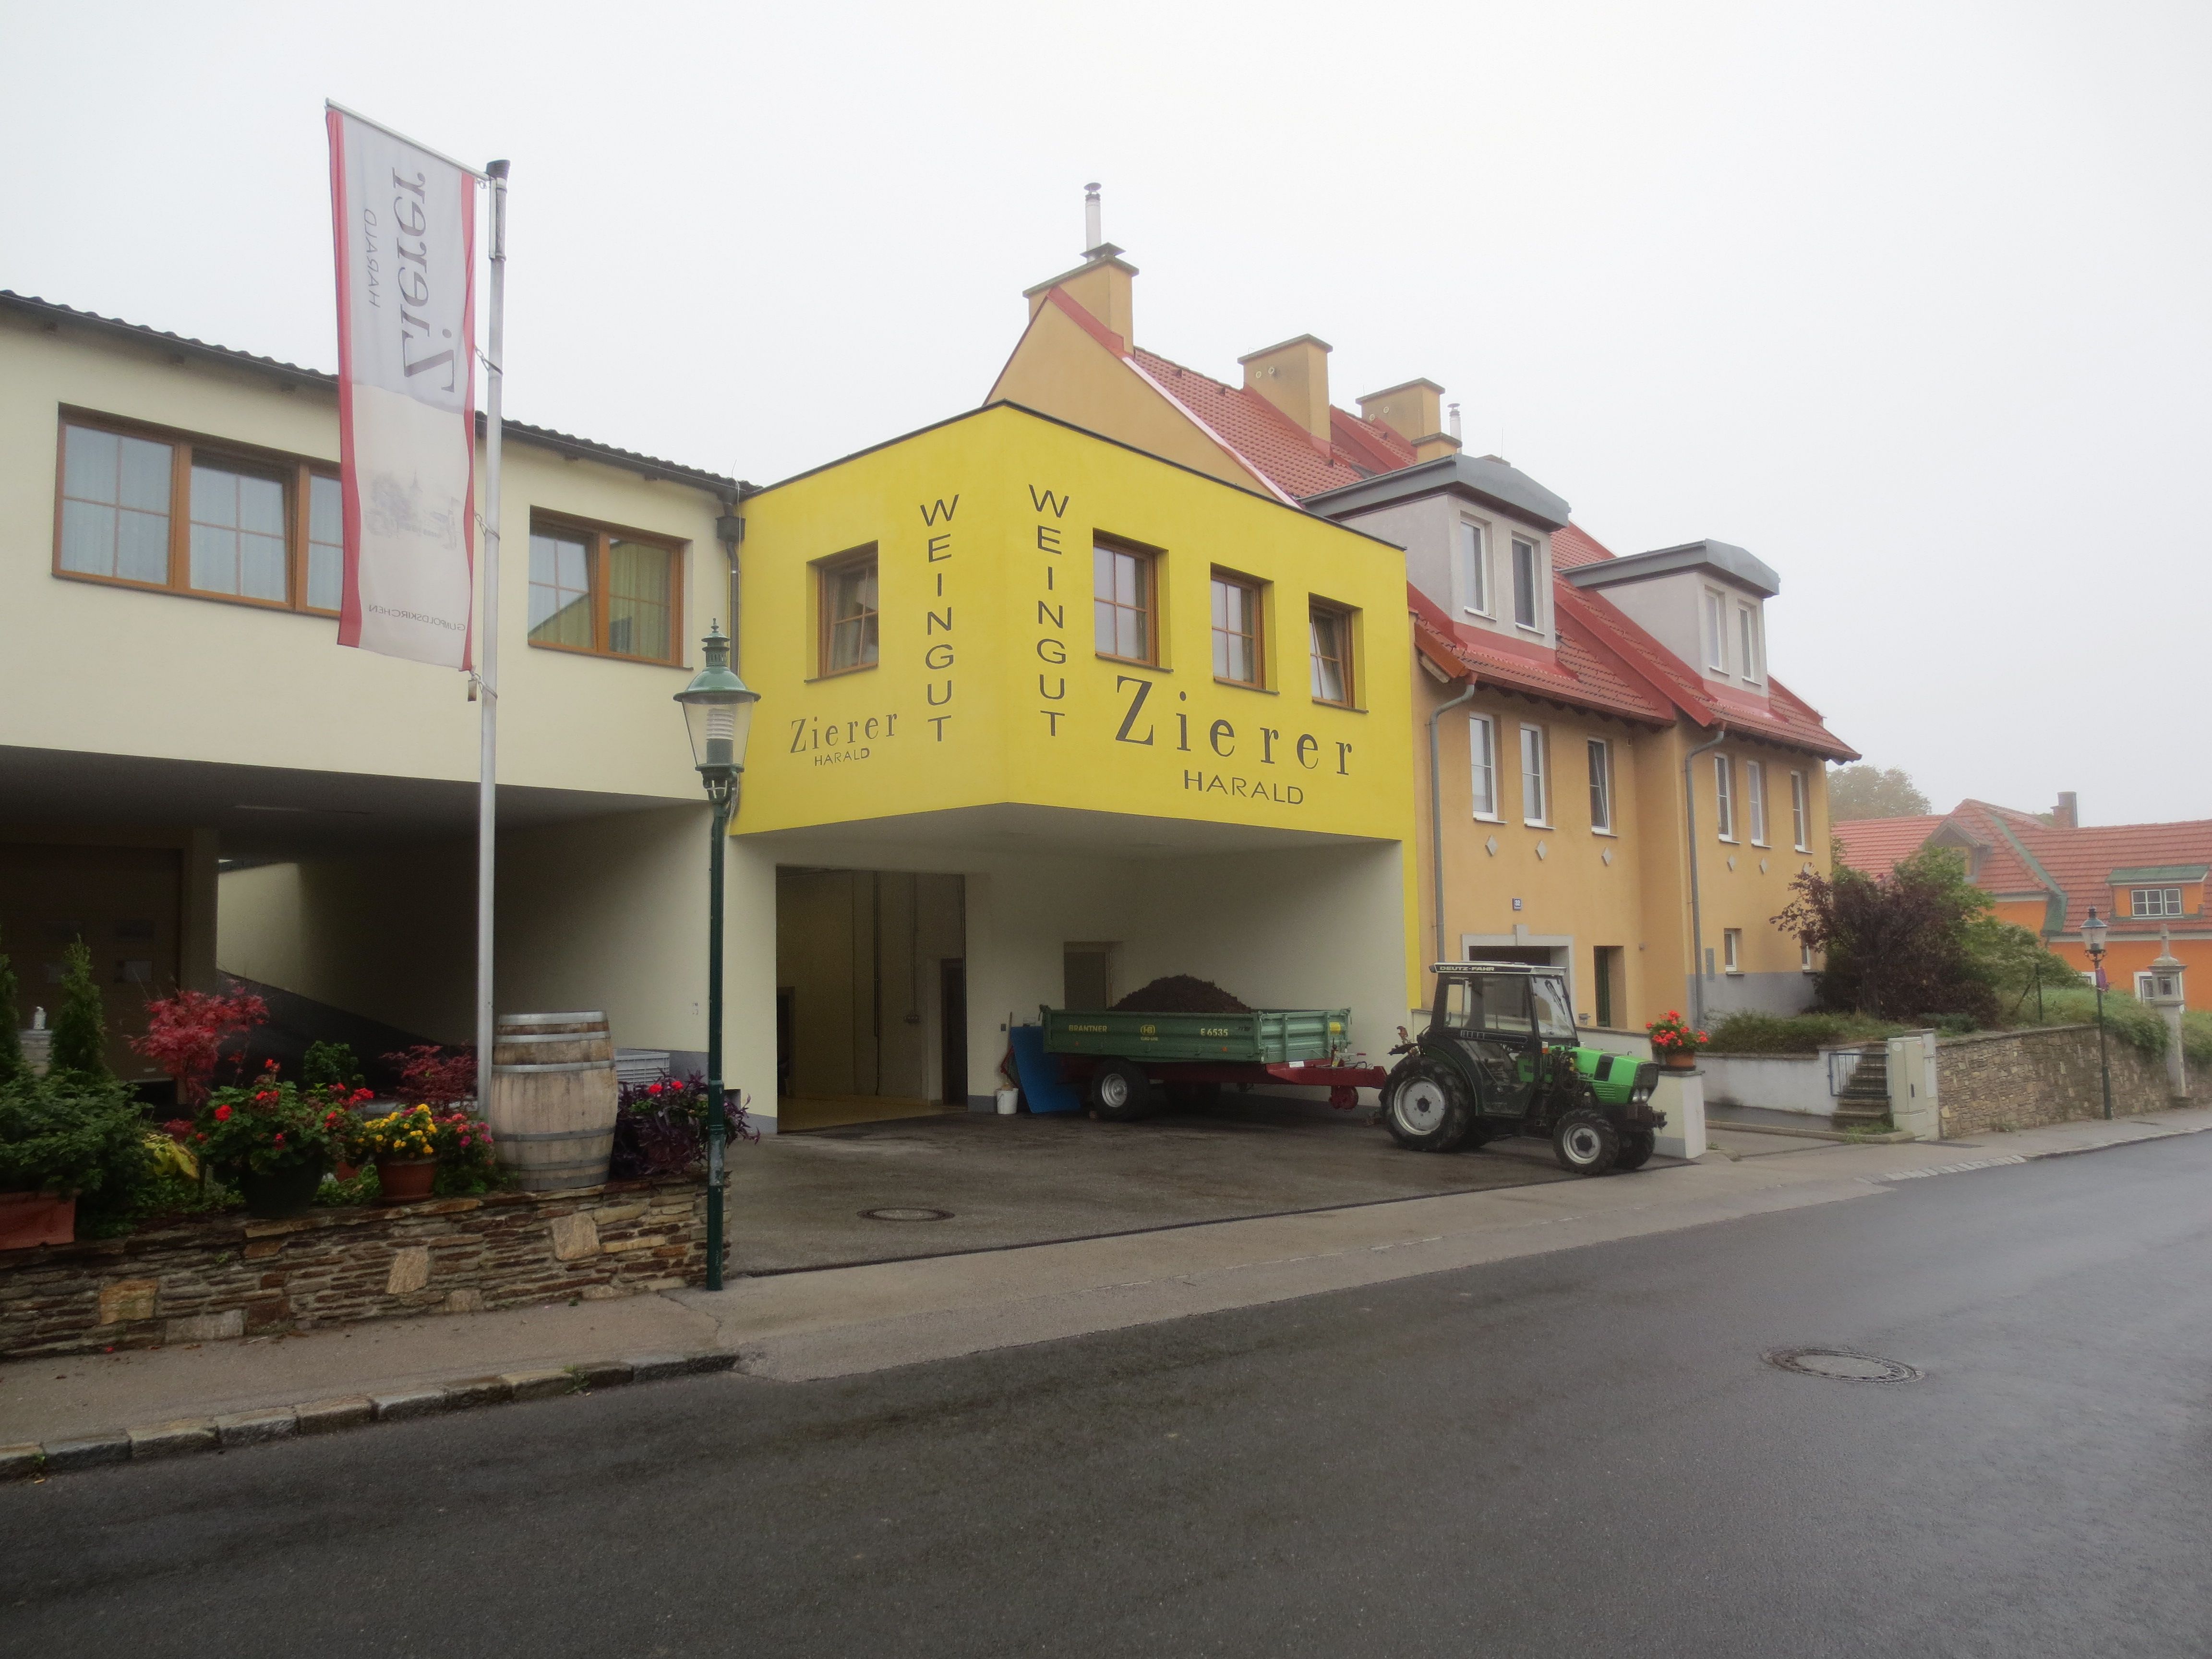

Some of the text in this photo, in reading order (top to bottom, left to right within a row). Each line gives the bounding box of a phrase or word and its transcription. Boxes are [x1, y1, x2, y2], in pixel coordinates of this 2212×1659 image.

[920, 494, 960, 742] WEINGUT
[1028, 484, 1070, 737] WEINGUT
[790, 711, 898, 754] Zierer
[1115, 674, 1353, 776] Zierer
[814, 747, 870, 767] HARALD
[1184, 769, 1304, 805] HARALD
[1207, 1028, 1228, 1037] 6535
